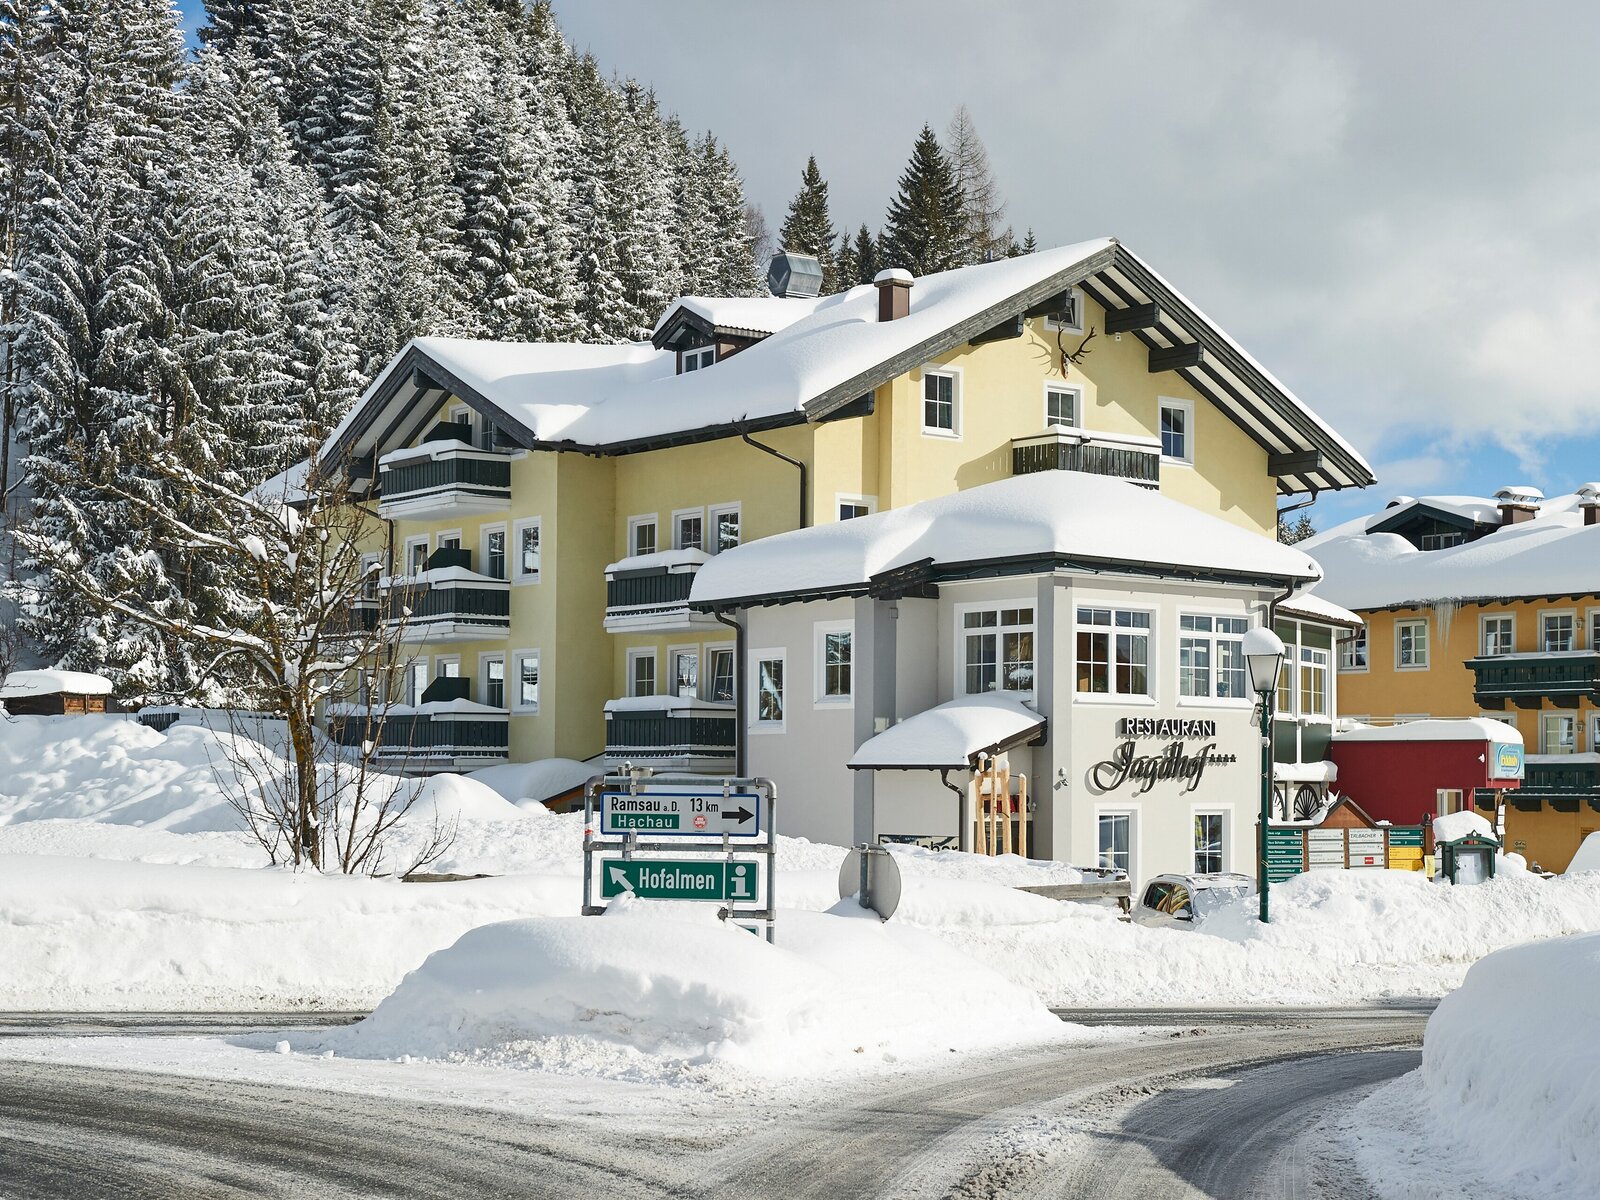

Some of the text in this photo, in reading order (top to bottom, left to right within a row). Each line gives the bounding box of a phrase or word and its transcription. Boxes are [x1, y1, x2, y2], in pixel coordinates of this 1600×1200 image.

[1093, 741, 1216, 793] Jagdhof
[611, 797, 660, 812] Ramsau
[690, 798, 703, 812] 13
[705, 802, 719, 812] km
[618, 815, 673, 828] Hachau
[639, 867, 715, 890] Hofalmen
